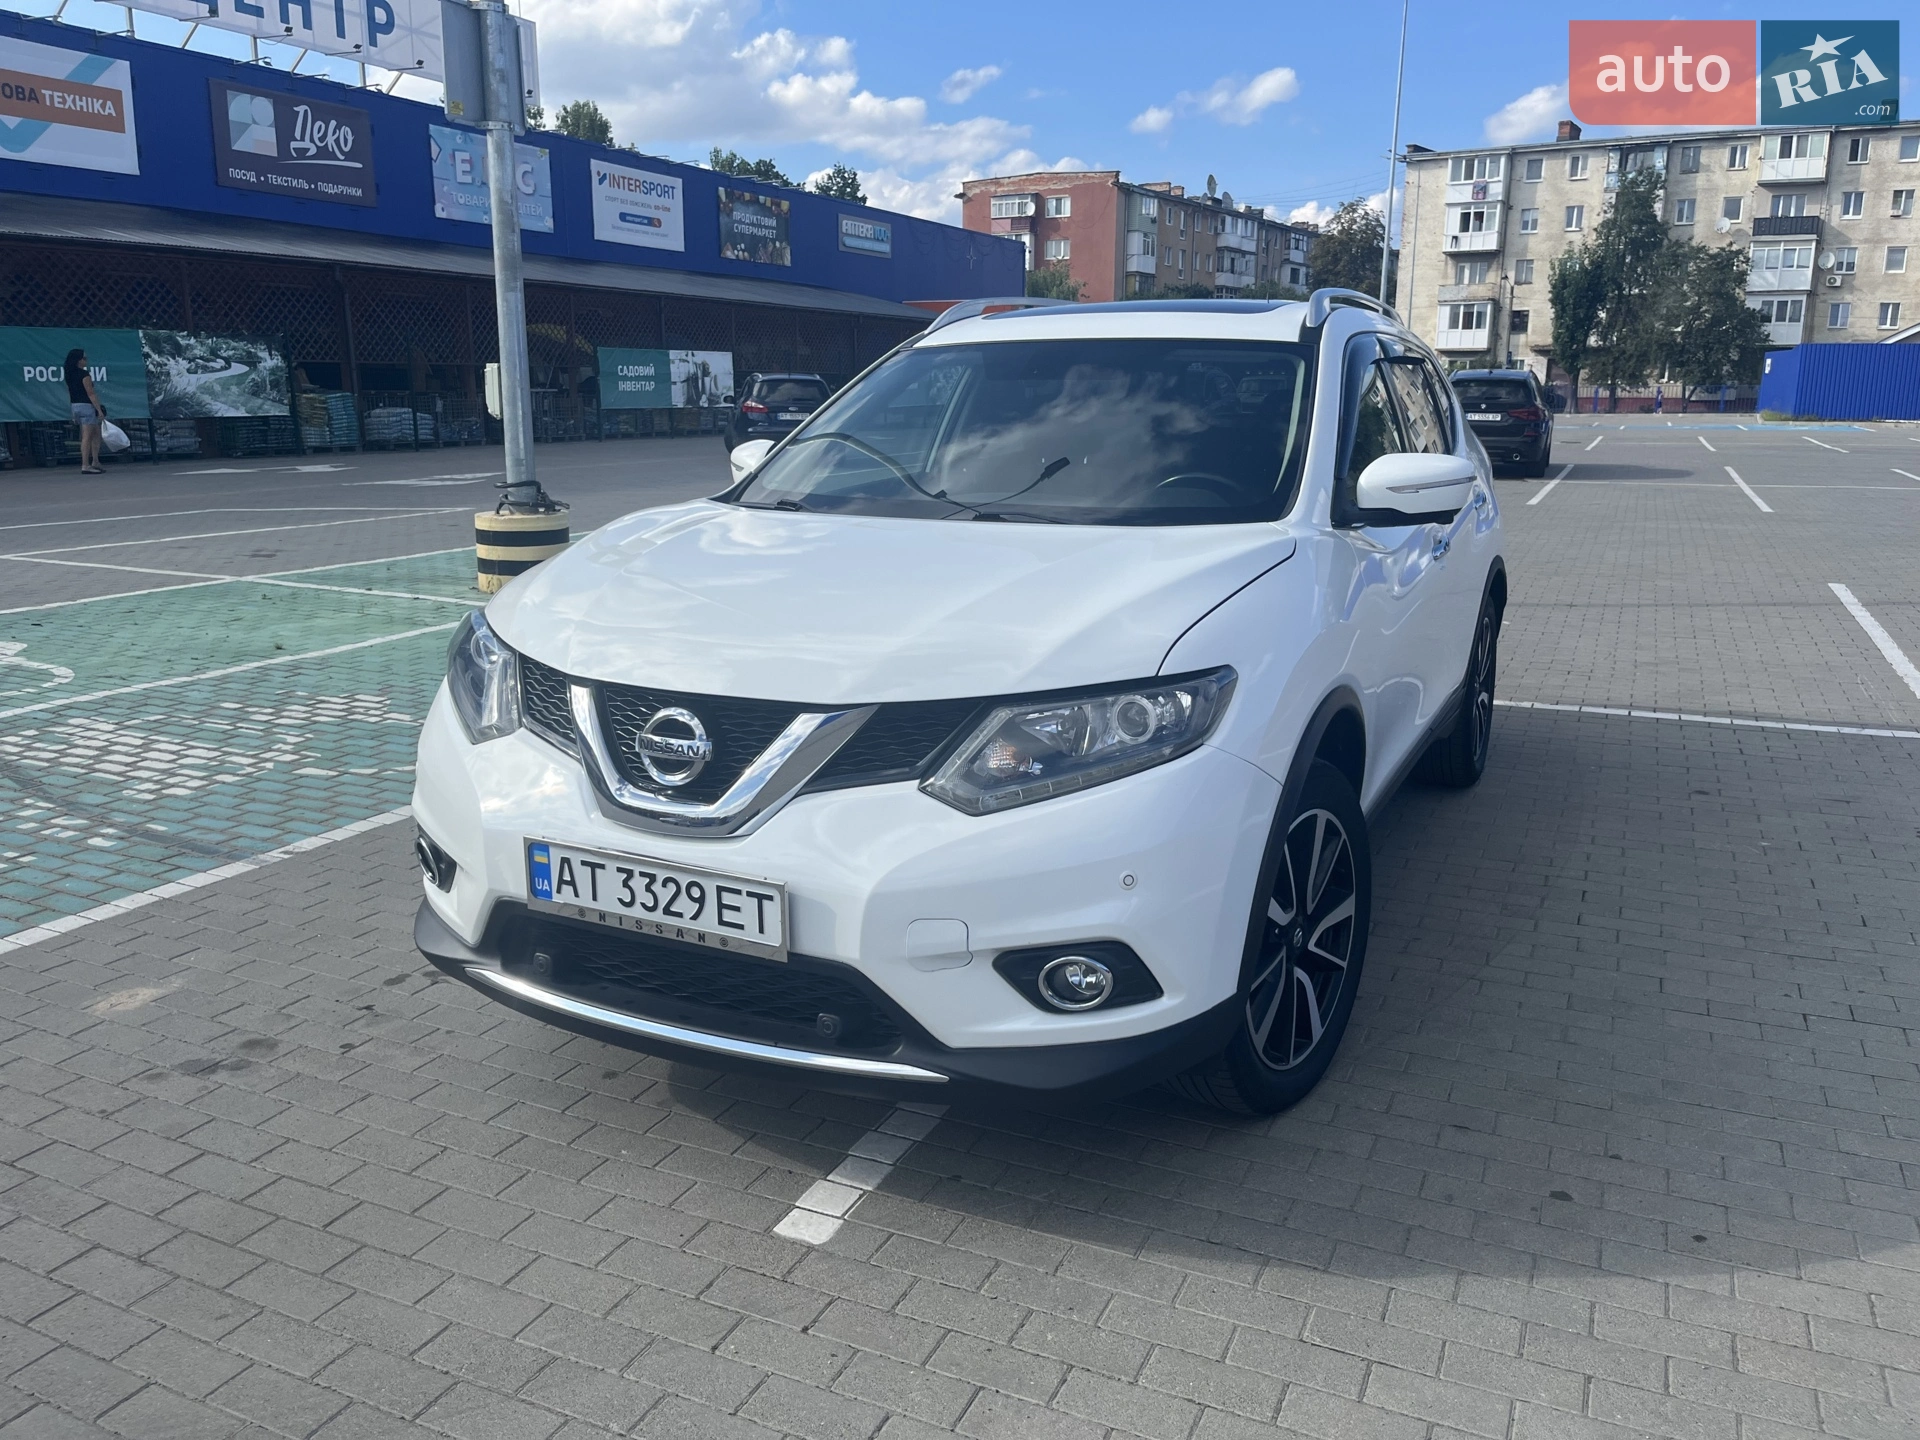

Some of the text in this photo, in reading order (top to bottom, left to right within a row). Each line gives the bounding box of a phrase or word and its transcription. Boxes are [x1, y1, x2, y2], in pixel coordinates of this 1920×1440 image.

[0, 82, 117, 117] ОВА ТЕХНІКА
[289, 104, 355, 160] Деко
[228, 167, 363, 197] ПОСУД ТЕКСТИЛЬ ПОДАРУНКИ
[608, 172, 677, 200] INTERSPORT
[732, 211, 777, 227] ПРОДУКТОВИЙ
[733, 225, 777, 239] СУПЕРМАРКЕТ
[617, 363, 655, 377] САДОВИЙ
[618, 380, 655, 393] ІНВЕНТАР
[639, 736, 701, 757] NISSAN
[535, 877, 551, 891] UA
[556, 856, 775, 935] AT 3329 ET
[598, 911, 707, 944] NISSAN
